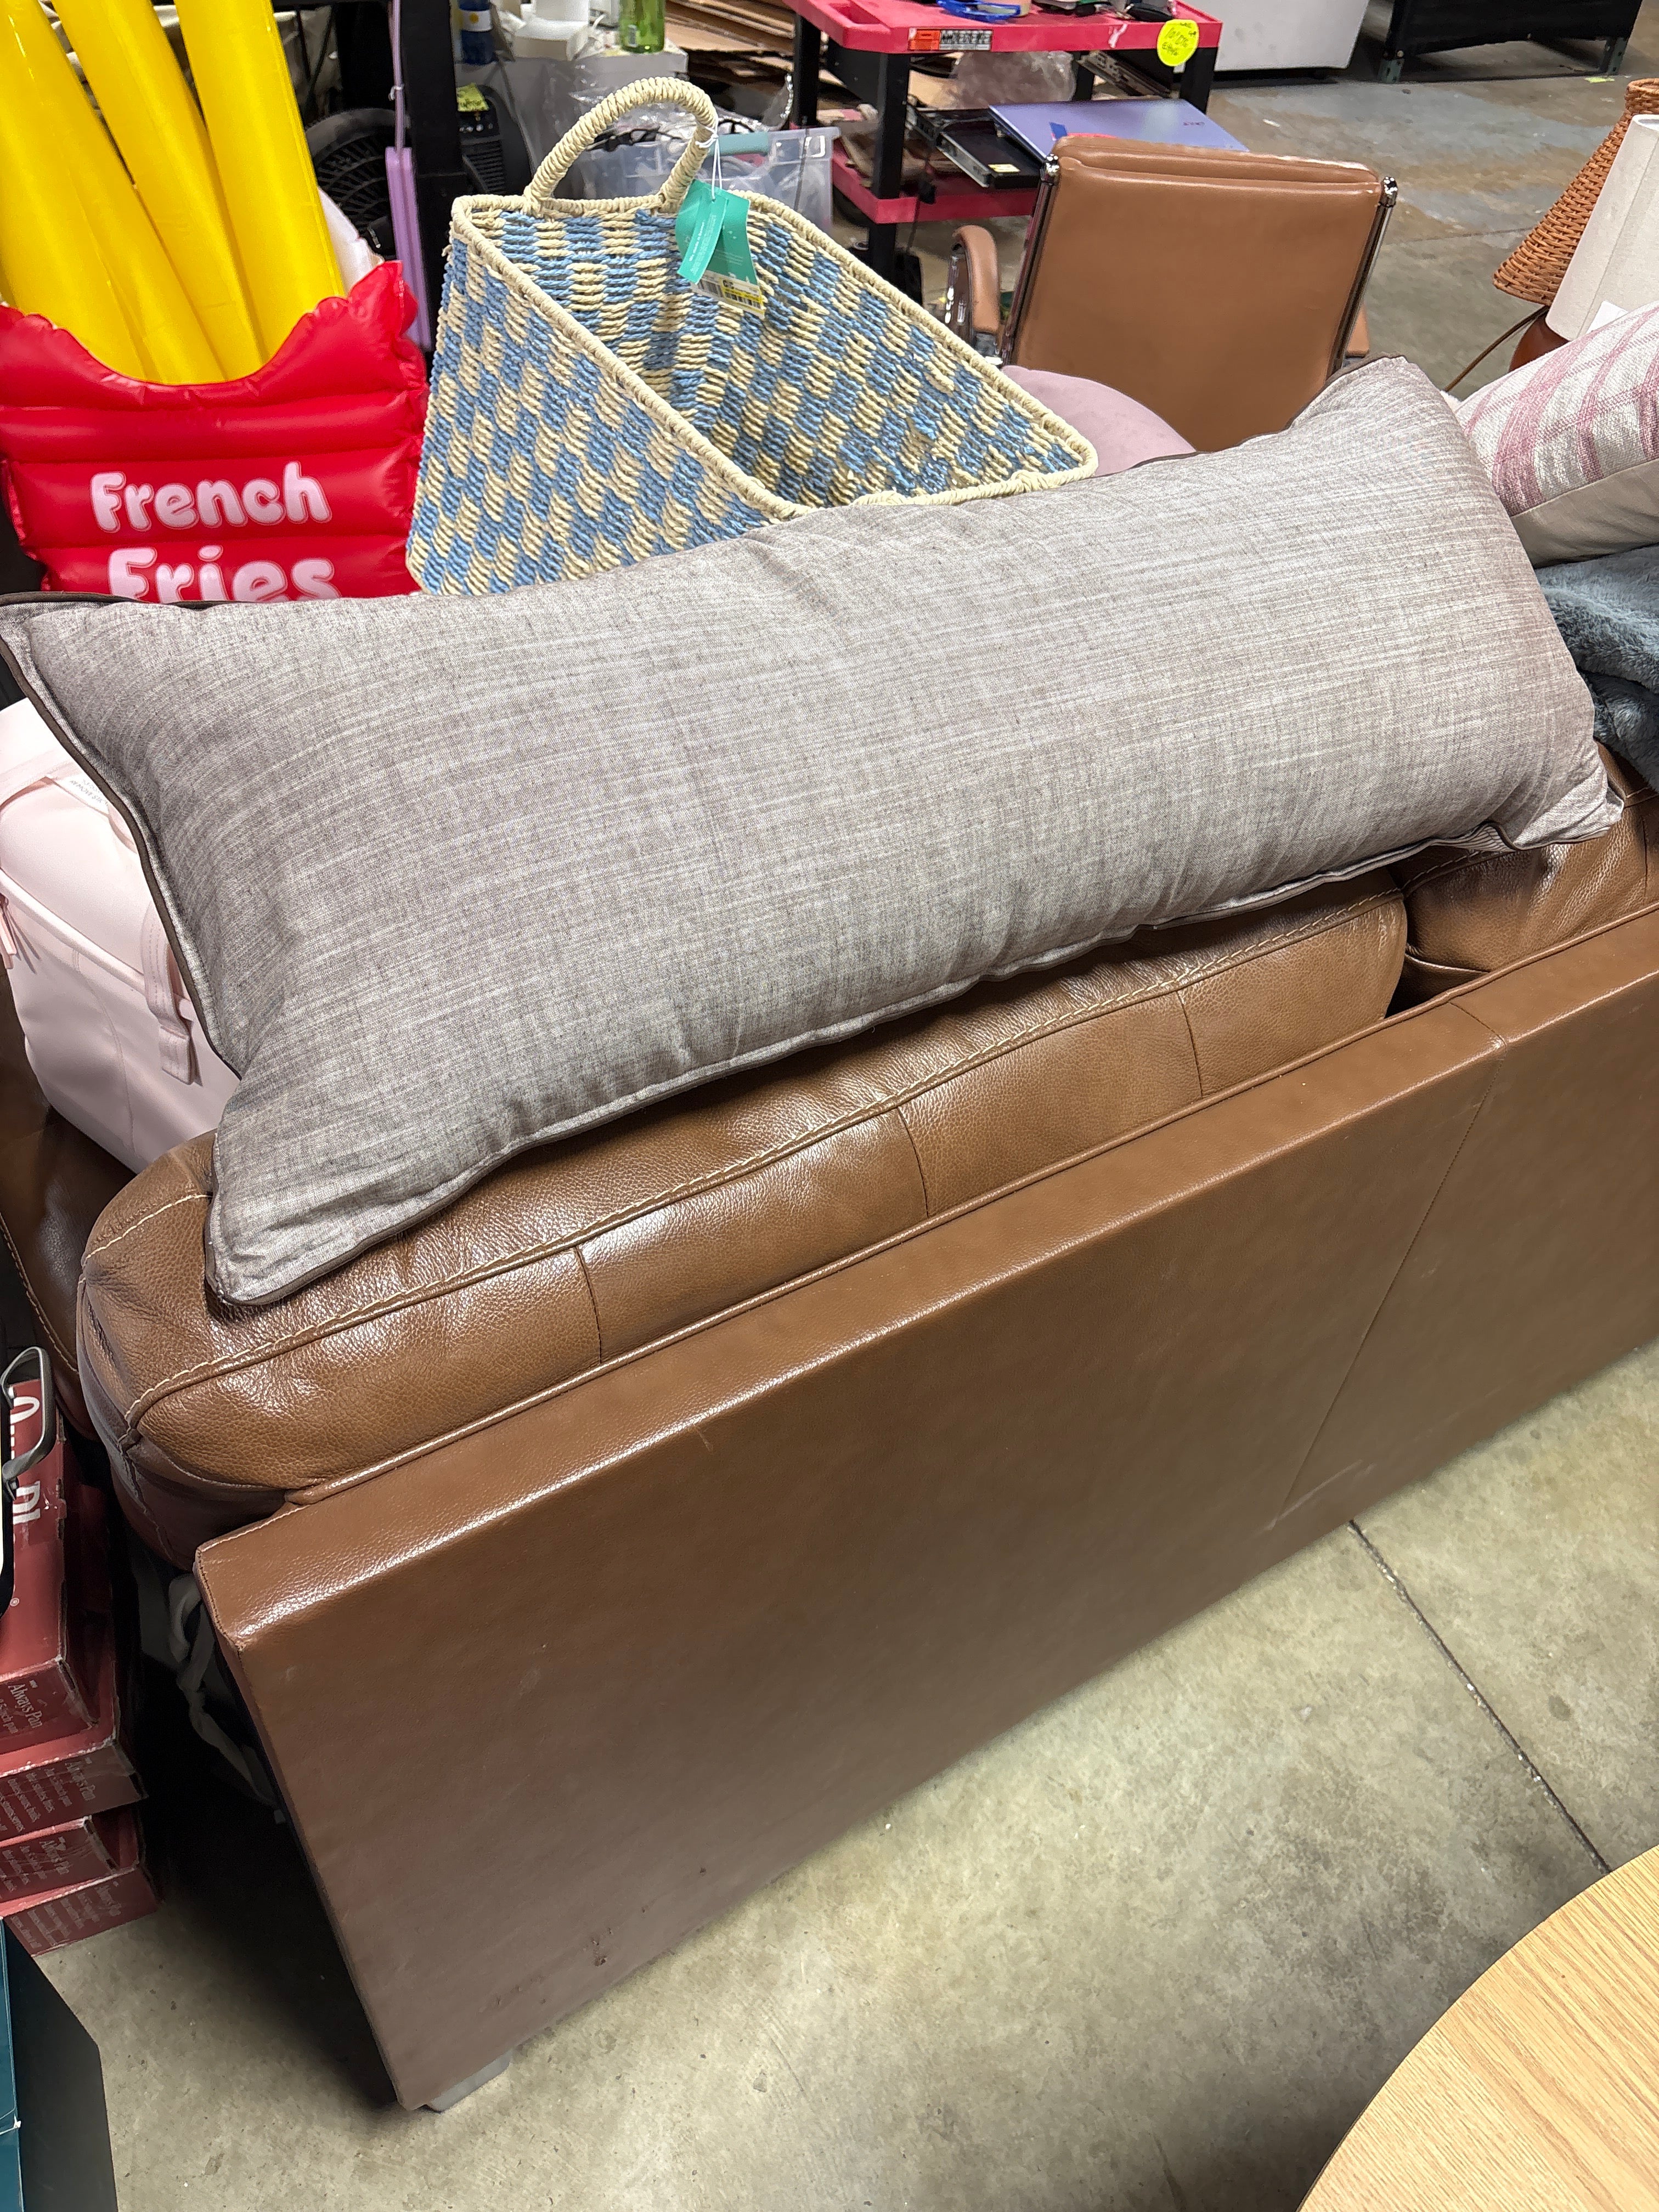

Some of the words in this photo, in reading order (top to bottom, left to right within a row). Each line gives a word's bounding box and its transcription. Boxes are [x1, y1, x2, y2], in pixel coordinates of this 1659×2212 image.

[89, 460, 332, 533] French
[108, 545, 341, 603] Fries
[8, 1684, 34, 1712] Always
[25, 1710, 43, 1729] Pan
